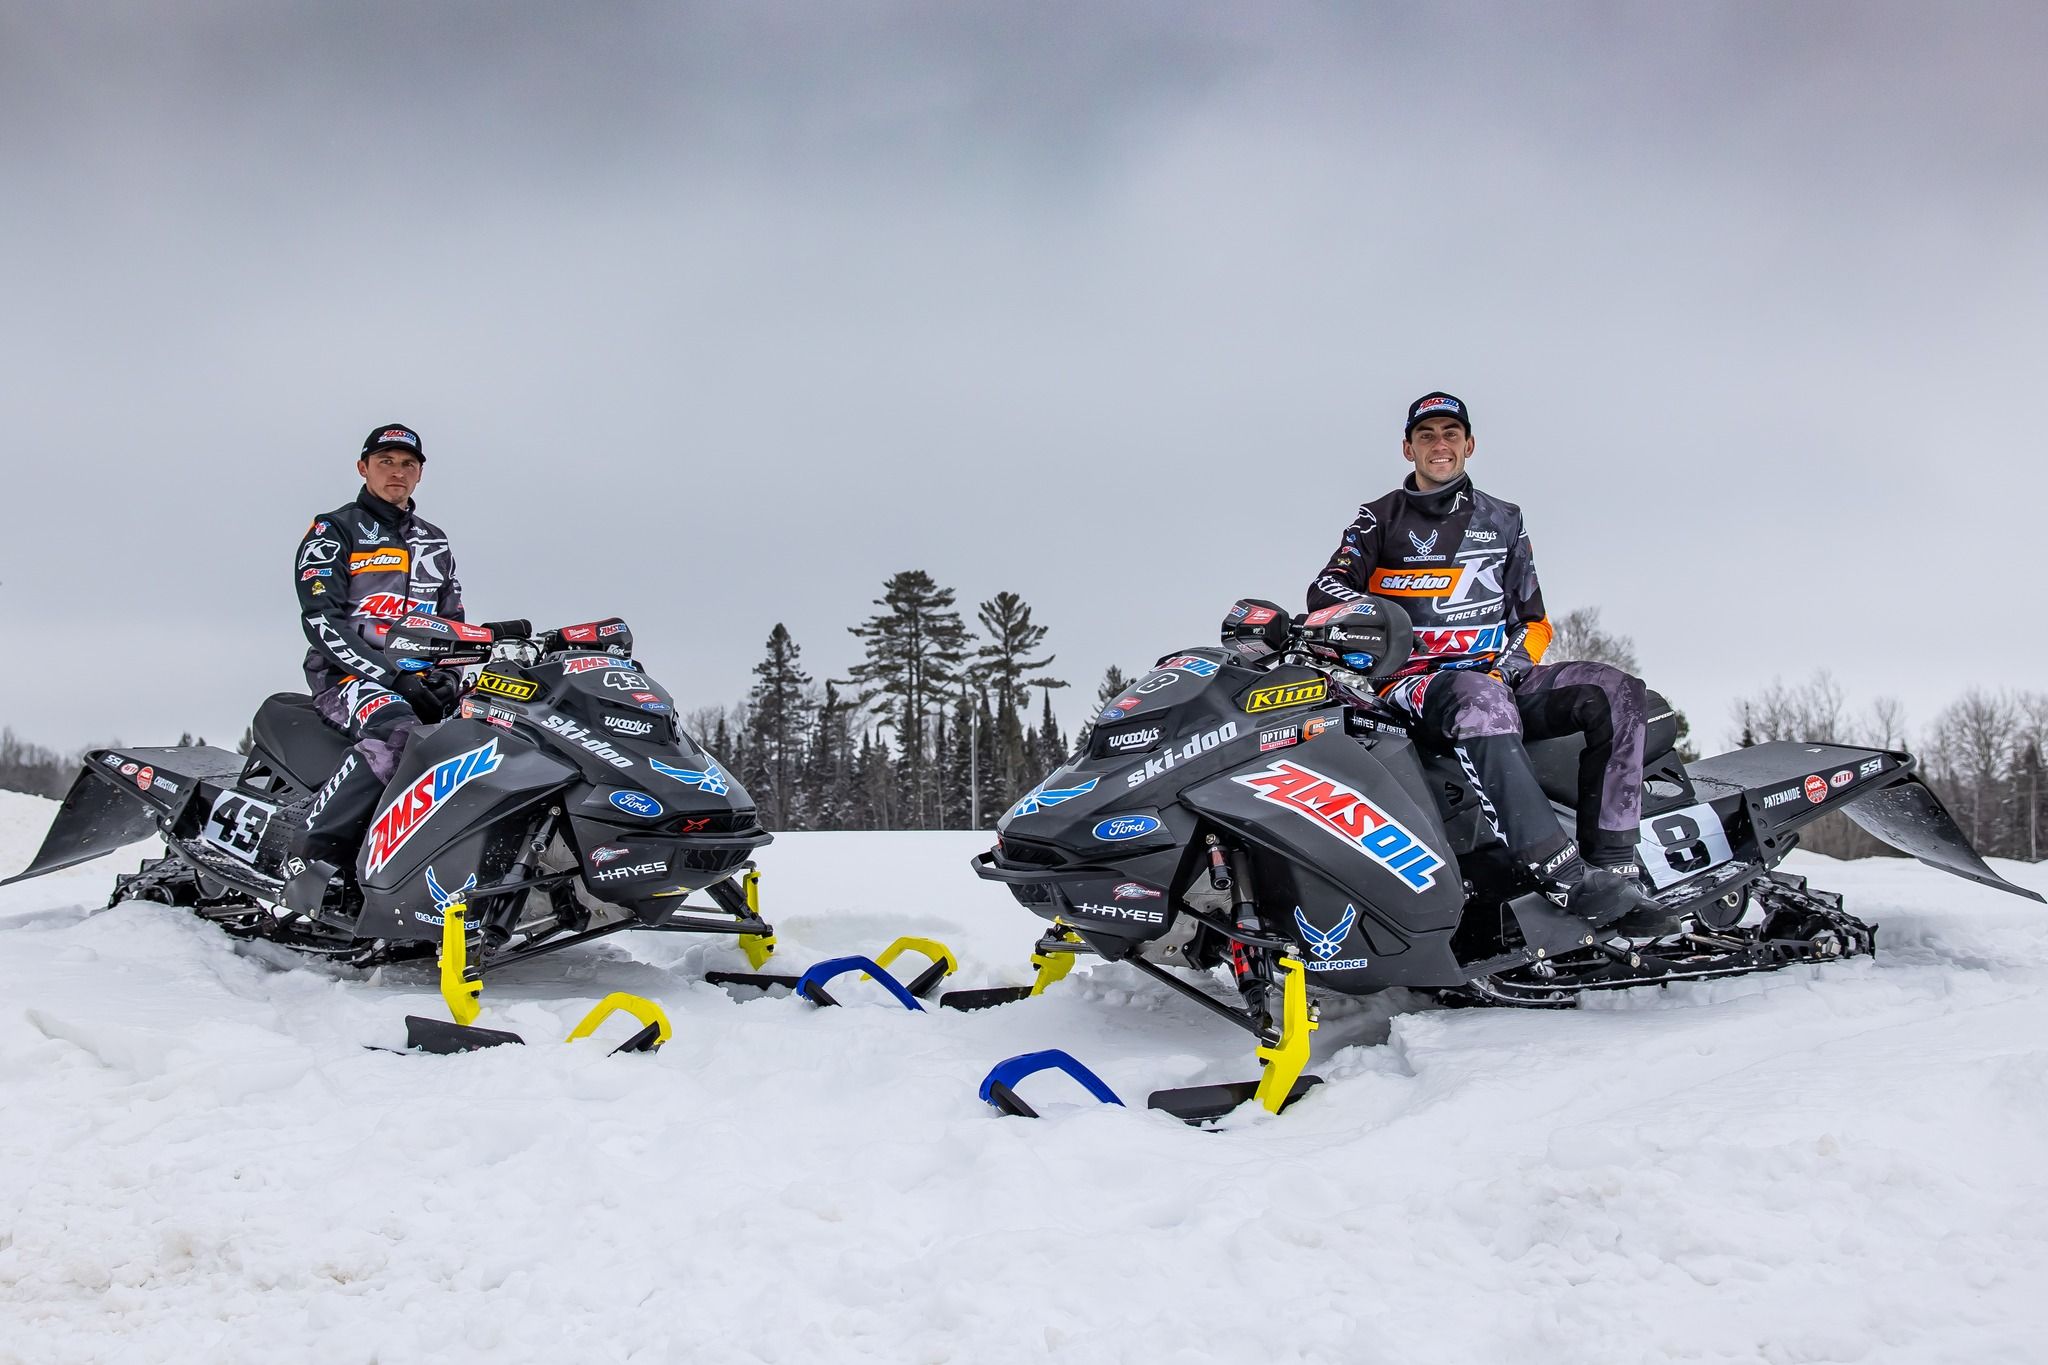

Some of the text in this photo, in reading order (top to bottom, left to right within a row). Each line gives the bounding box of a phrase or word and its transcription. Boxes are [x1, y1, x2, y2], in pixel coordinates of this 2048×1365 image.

[350, 554, 402, 570] ski-doo
[1381, 573, 1452, 591] ski-doo
[401, 615, 449, 634] AMSOIL
[1446, 608, 1478, 623] RACE
[563, 657, 637, 675] AMSOIL
[480, 674, 530, 698] Klim
[603, 671, 650, 690] 43
[1252, 684, 1324, 709] Klim
[490, 708, 513, 722] OPTIMA
[1312, 717, 1340, 731] BOOST
[1351, 715, 1374, 729] HAYES
[604, 716, 653, 735] woody's
[1263, 727, 1296, 743] OPTIMA
[1386, 725, 1407, 735] FOSTER
[541, 715, 634, 768] ski-doo
[1108, 728, 1160, 751] woody's
[1127, 721, 1238, 788] ski-doo
[1861, 759, 1882, 775] SSI
[619, 793, 651, 813] Ford
[1763, 787, 1801, 809] PATENAUDE
[366, 737, 504, 880] AMSOIL
[211, 796, 268, 855] 43
[1109, 819, 1145, 837] Ford
[1230, 759, 1447, 894] AMSOIL
[1651, 813, 1711, 873] 8
[1546, 844, 1577, 873] Klim
[592, 861, 668, 881] HAYES
[1073, 903, 1164, 924] HAYES
[1309, 962, 1327, 971] AIR
[1329, 959, 1368, 970] FORCE
